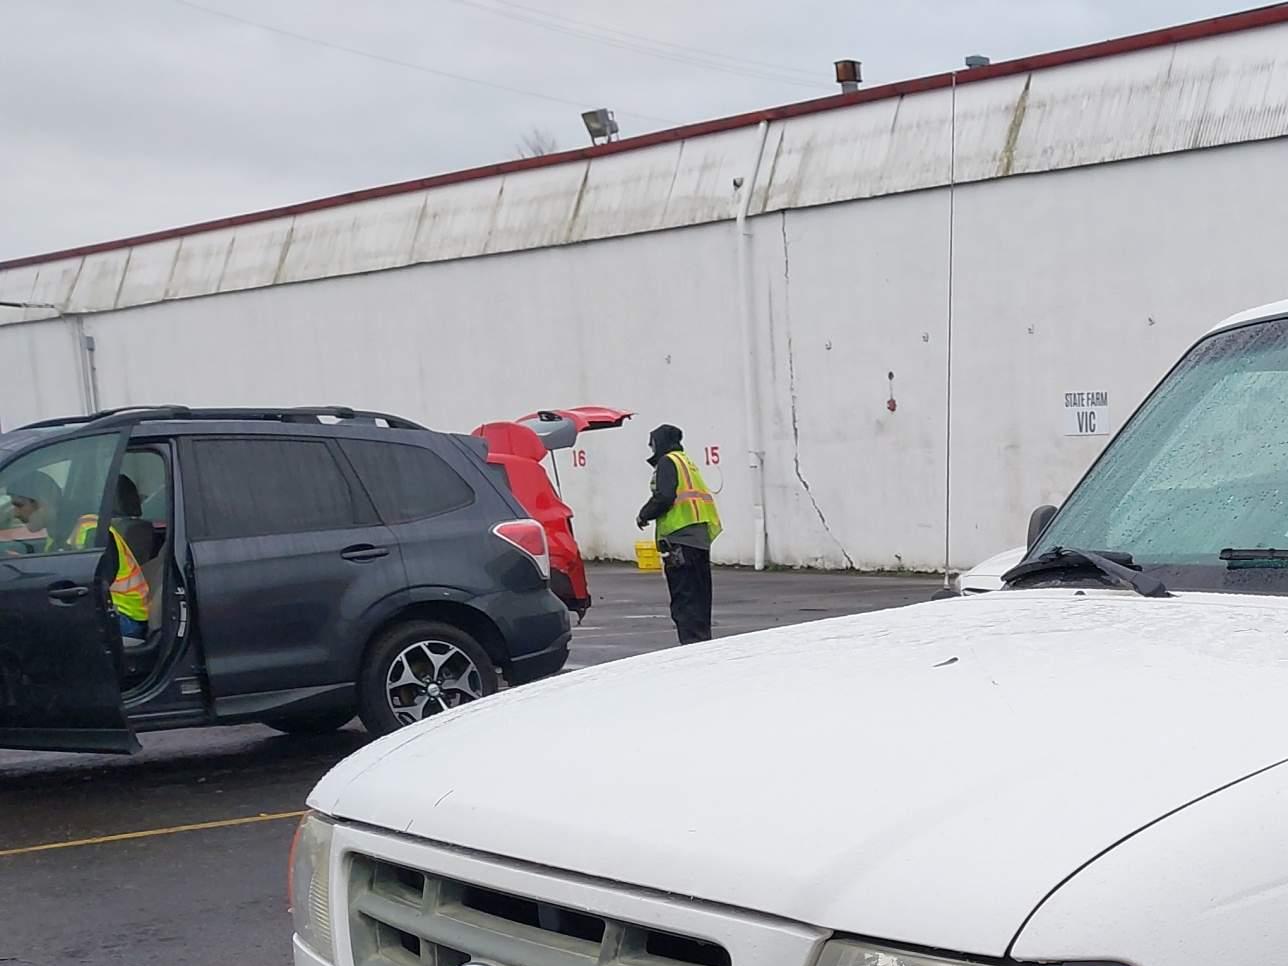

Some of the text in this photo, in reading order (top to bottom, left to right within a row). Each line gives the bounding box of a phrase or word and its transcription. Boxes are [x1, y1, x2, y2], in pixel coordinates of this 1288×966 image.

[1064, 392, 1108, 407] STATE FARM
[1077, 411, 1096, 433] VIC
[572, 449, 587, 467] 16
[704, 446, 720, 466] 15
